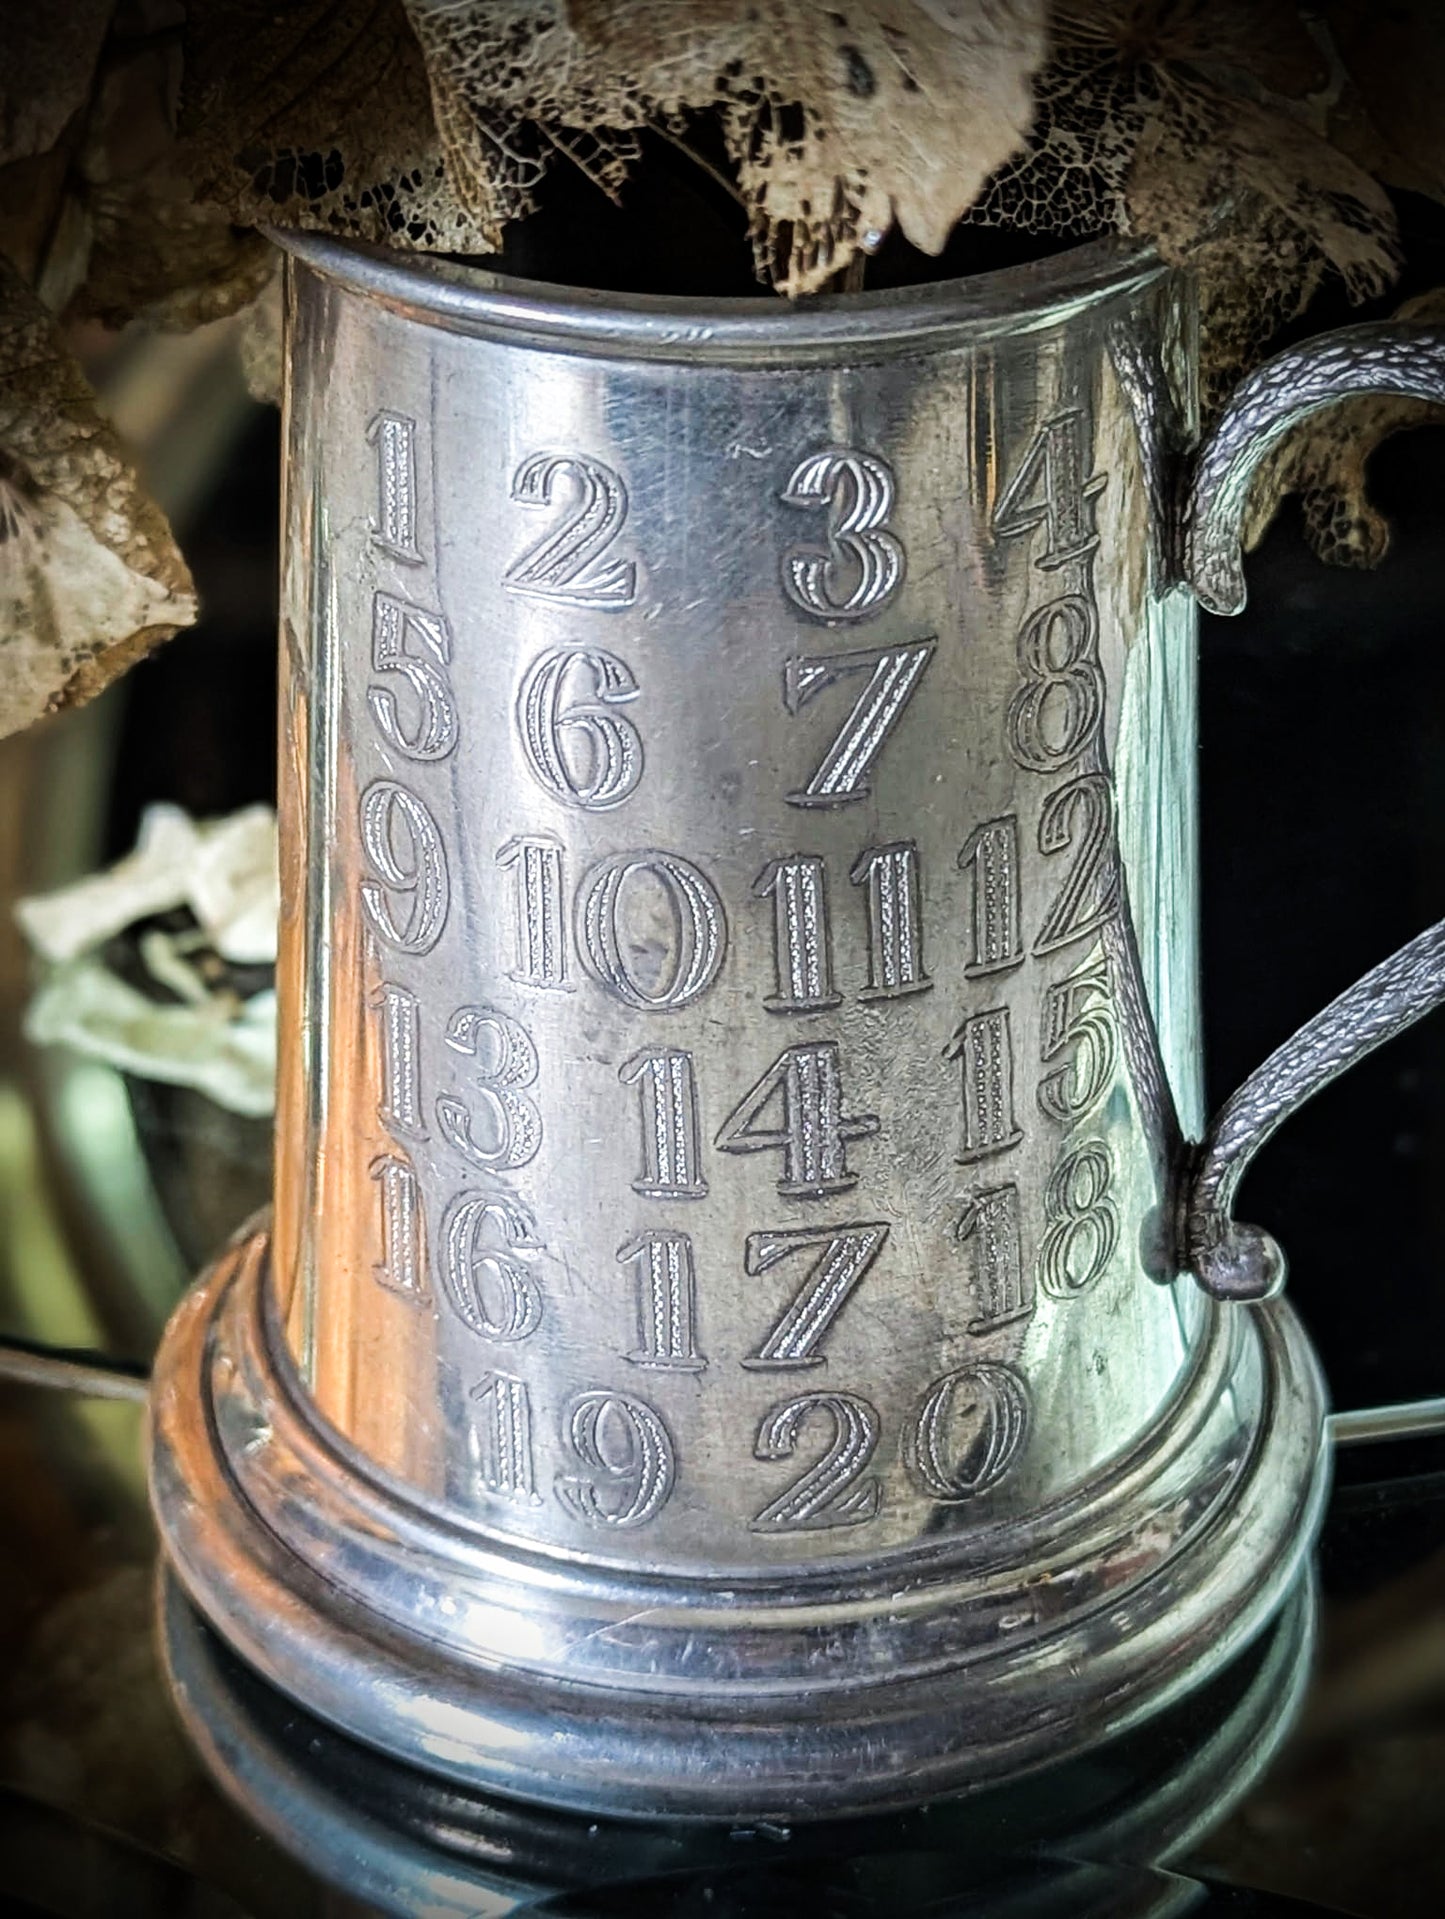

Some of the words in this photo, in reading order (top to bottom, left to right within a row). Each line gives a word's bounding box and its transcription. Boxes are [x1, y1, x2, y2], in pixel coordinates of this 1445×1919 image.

[367, 409, 425, 566] 1
[505, 449, 637, 611] 2
[781, 447, 907, 622] 3
[994, 409, 1108, 570] 4
[368, 591, 459, 761] 5
[517, 641, 645, 810] 6
[785, 635, 938, 808] 7
[1007, 595, 1106, 773] 8
[360, 779, 450, 955] 9
[495, 834, 728, 1011] 10
[752, 839, 933, 1013] 11
[958, 773, 1122, 978] 12
[370, 980, 543, 1174] 13
[618, 1041, 880, 1198] 14
[942, 950, 1122, 1165] 15
[369, 1152, 547, 1343] 16
[616, 1222, 890, 1372] 17
[954, 1136, 1120, 1335] 18
[470, 1371, 676, 1528] 19
[747, 1362, 1030, 1534] 20
